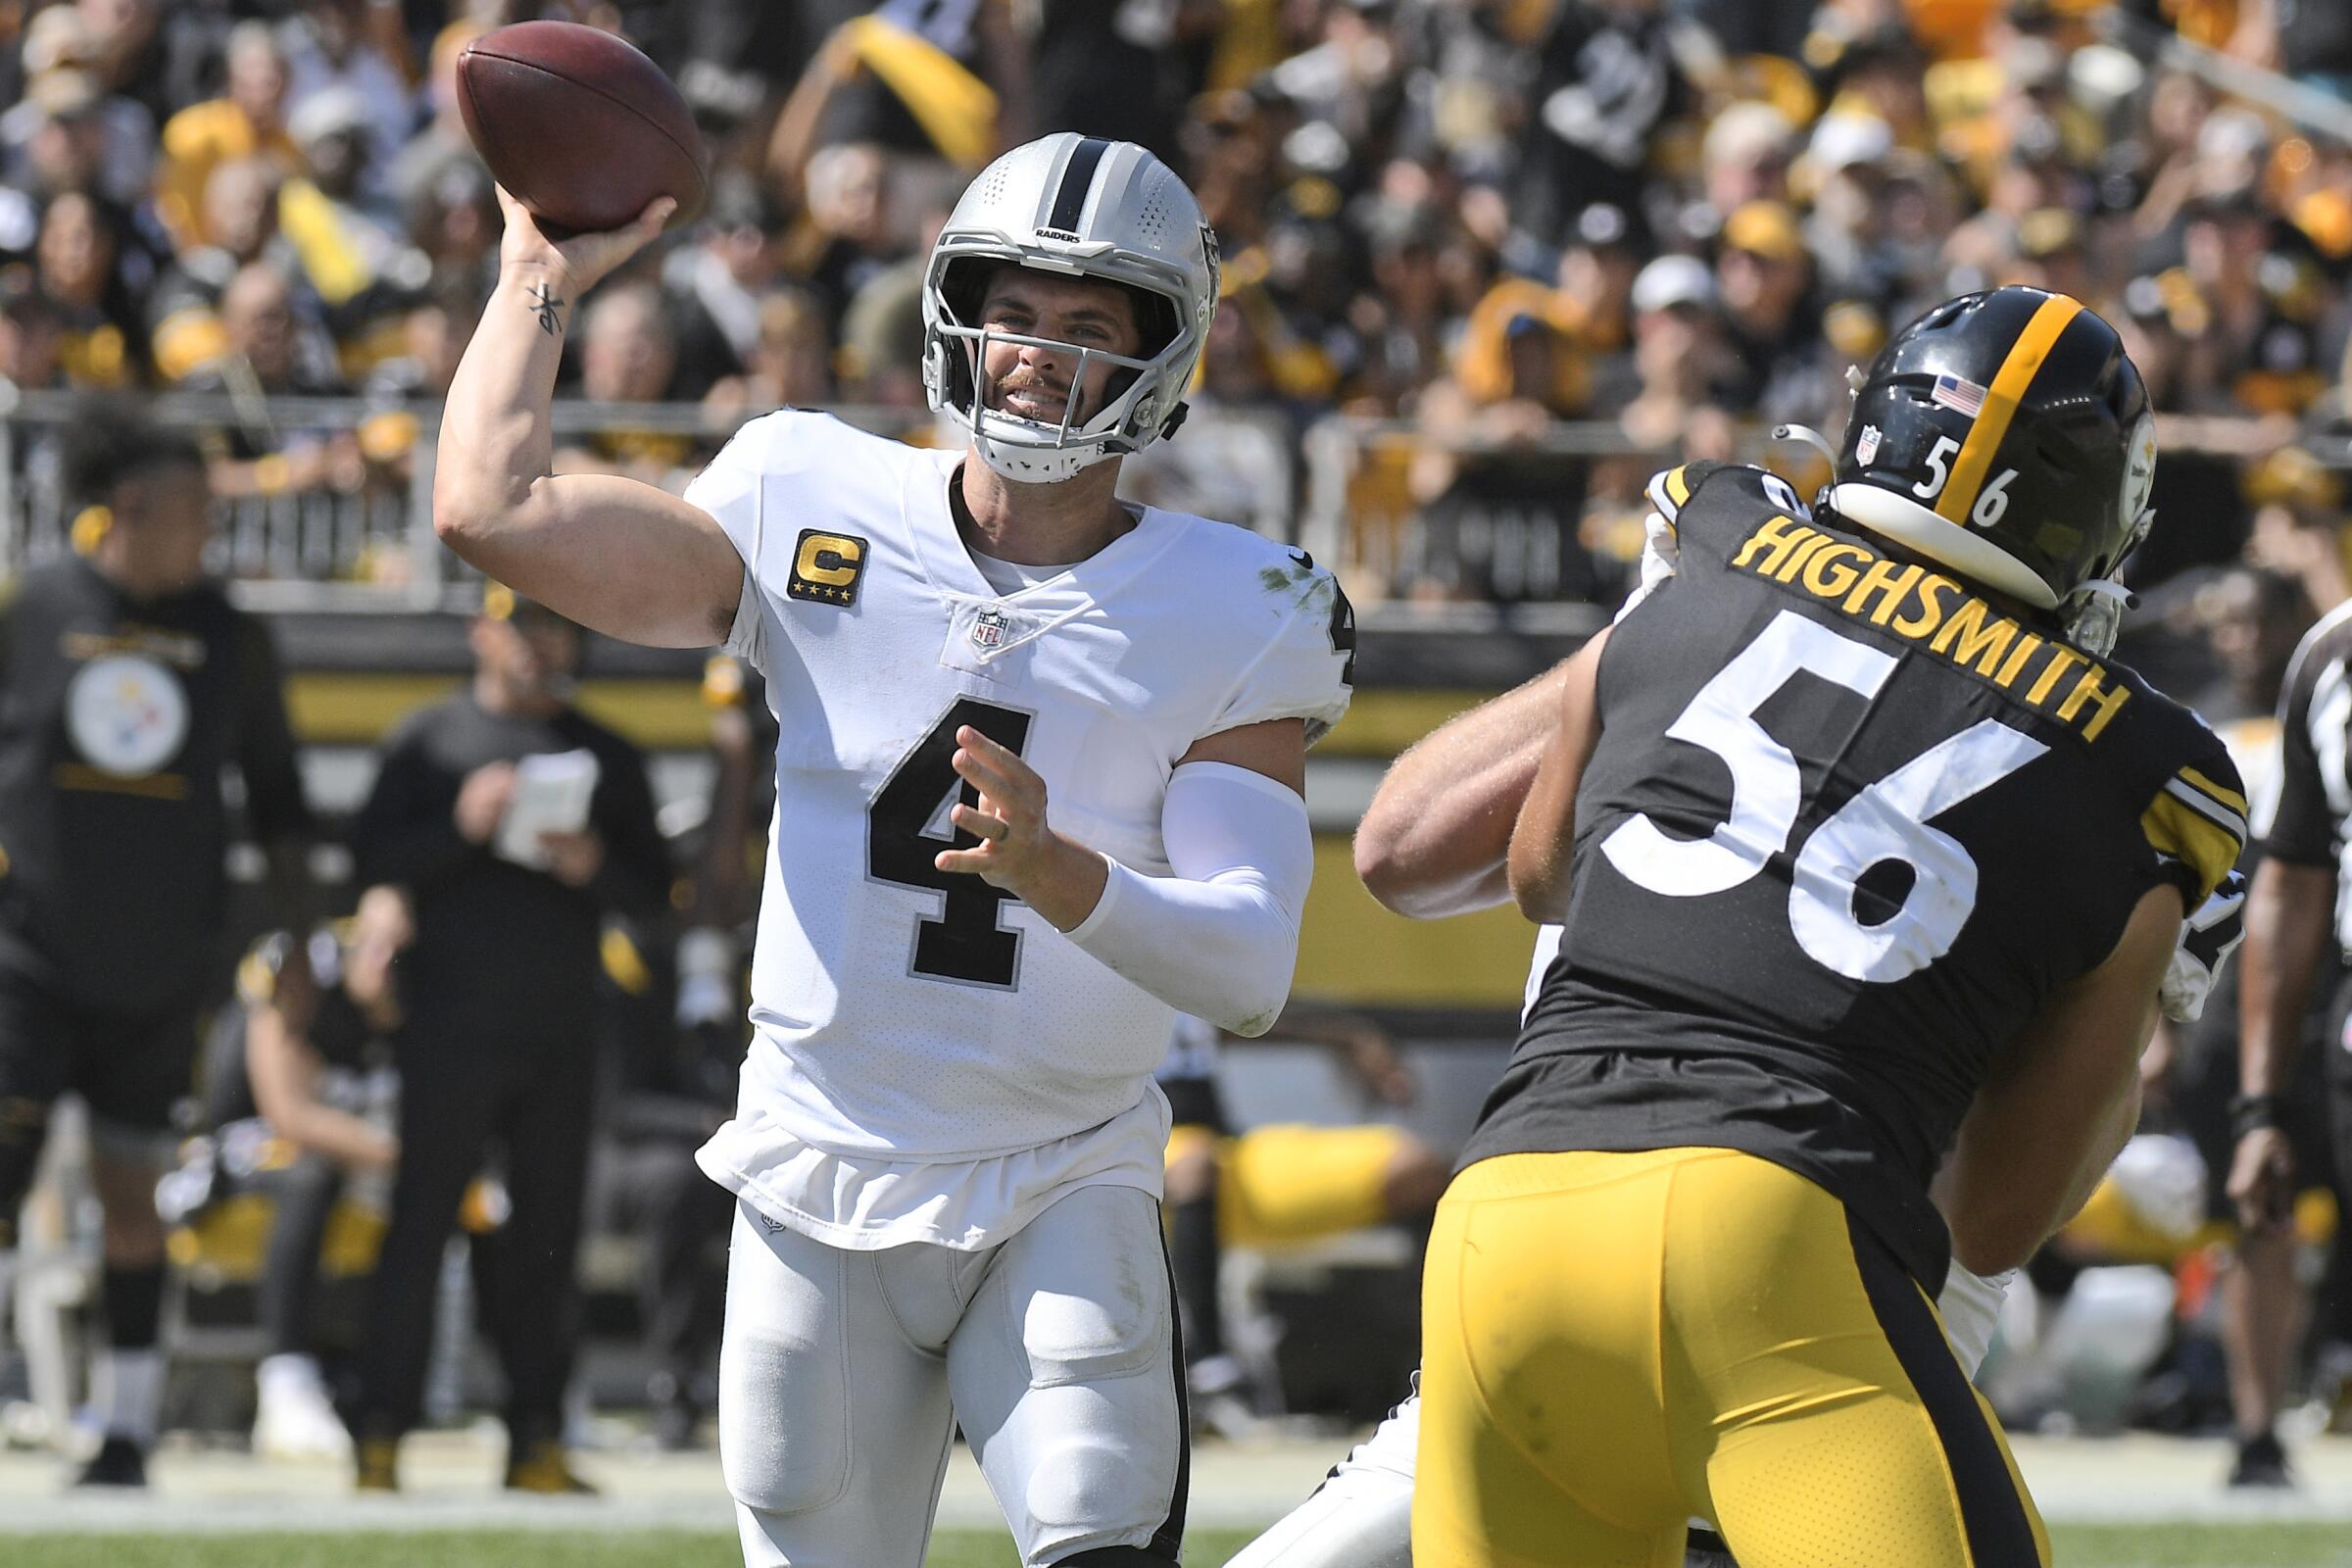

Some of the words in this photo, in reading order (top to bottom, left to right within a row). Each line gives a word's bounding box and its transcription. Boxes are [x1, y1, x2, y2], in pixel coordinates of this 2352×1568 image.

[1035, 229, 1081, 244] RAIDERS
[796, 534, 860, 587] C
[1732, 514, 2132, 744] HIGHSMITH
[975, 624, 1003, 644] NFL
[863, 691, 1039, 994] 4
[1600, 609, 2051, 983] 56
